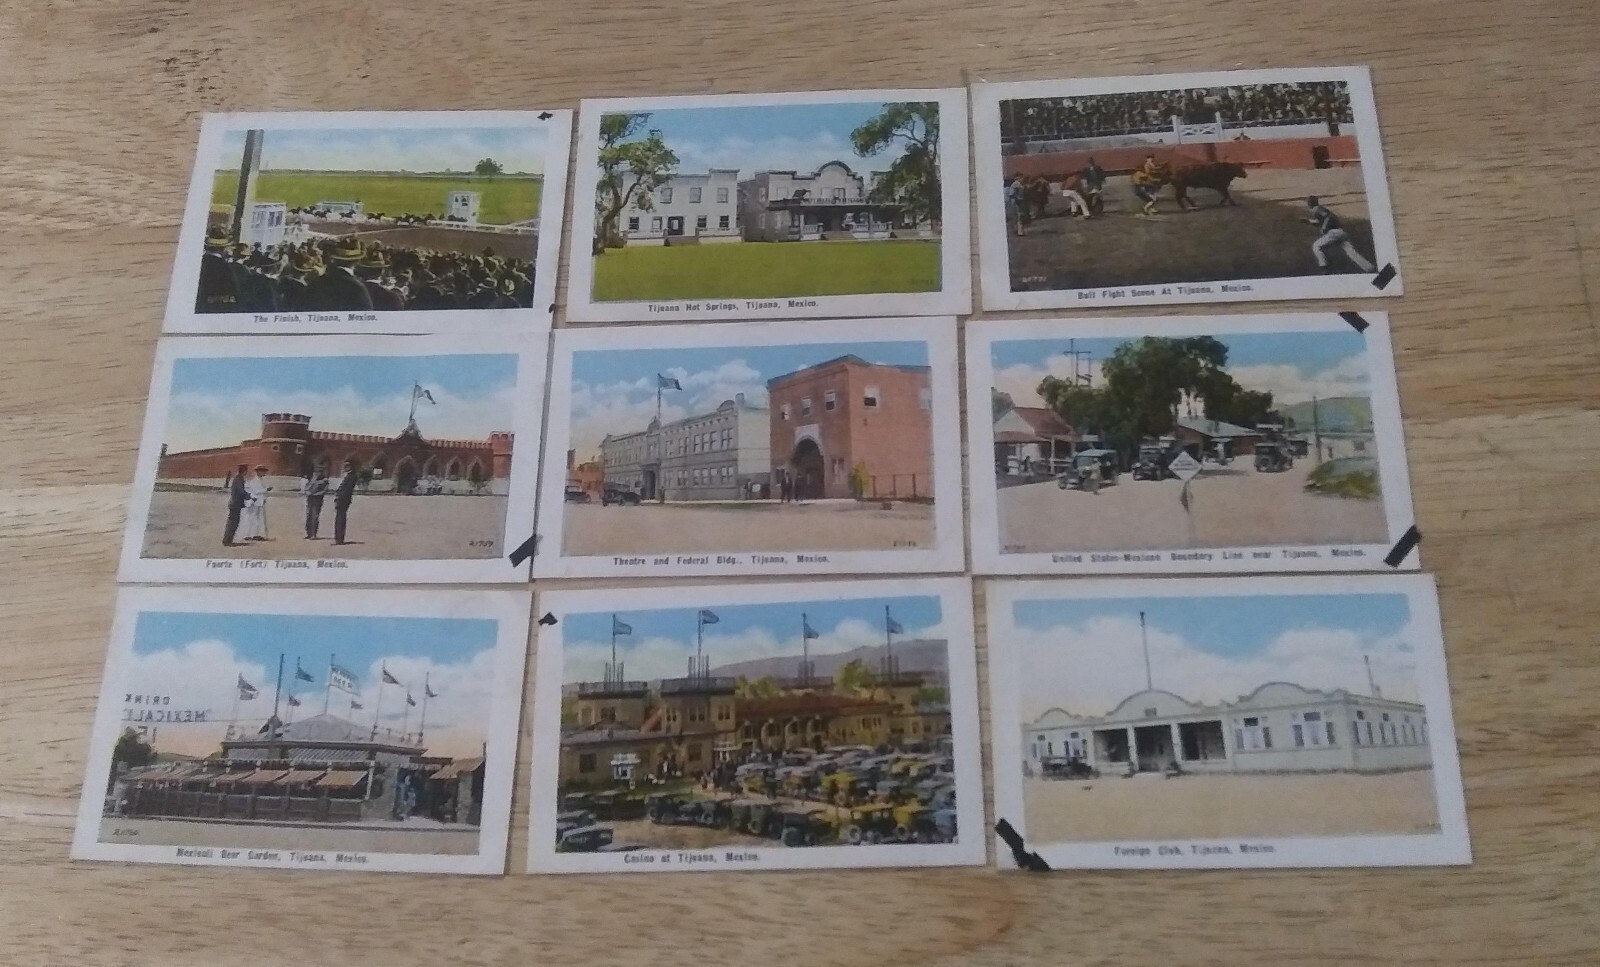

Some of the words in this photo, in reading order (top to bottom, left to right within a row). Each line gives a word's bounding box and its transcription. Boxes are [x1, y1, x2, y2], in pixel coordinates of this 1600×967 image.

[1102, 290, 1126, 299] Fight
[1161, 288, 1172, 296] At
[648, 304, 680, 313] Tijuana
[686, 303, 700, 312] Hot
[706, 302, 739, 313] Springs,
[746, 301, 781, 310] Tijuana,
[788, 300, 819, 308] Mexico.
[253, 315, 268, 323] The
[274, 314, 301, 324] Finish,
[308, 314, 341, 323] Tijuana,
[1222, 551, 1243, 560] Line
[613, 557, 646, 566] Theatre
[653, 557, 669, 566] and
[677, 556, 709, 565] Federal
[661, 853, 671, 863] at
